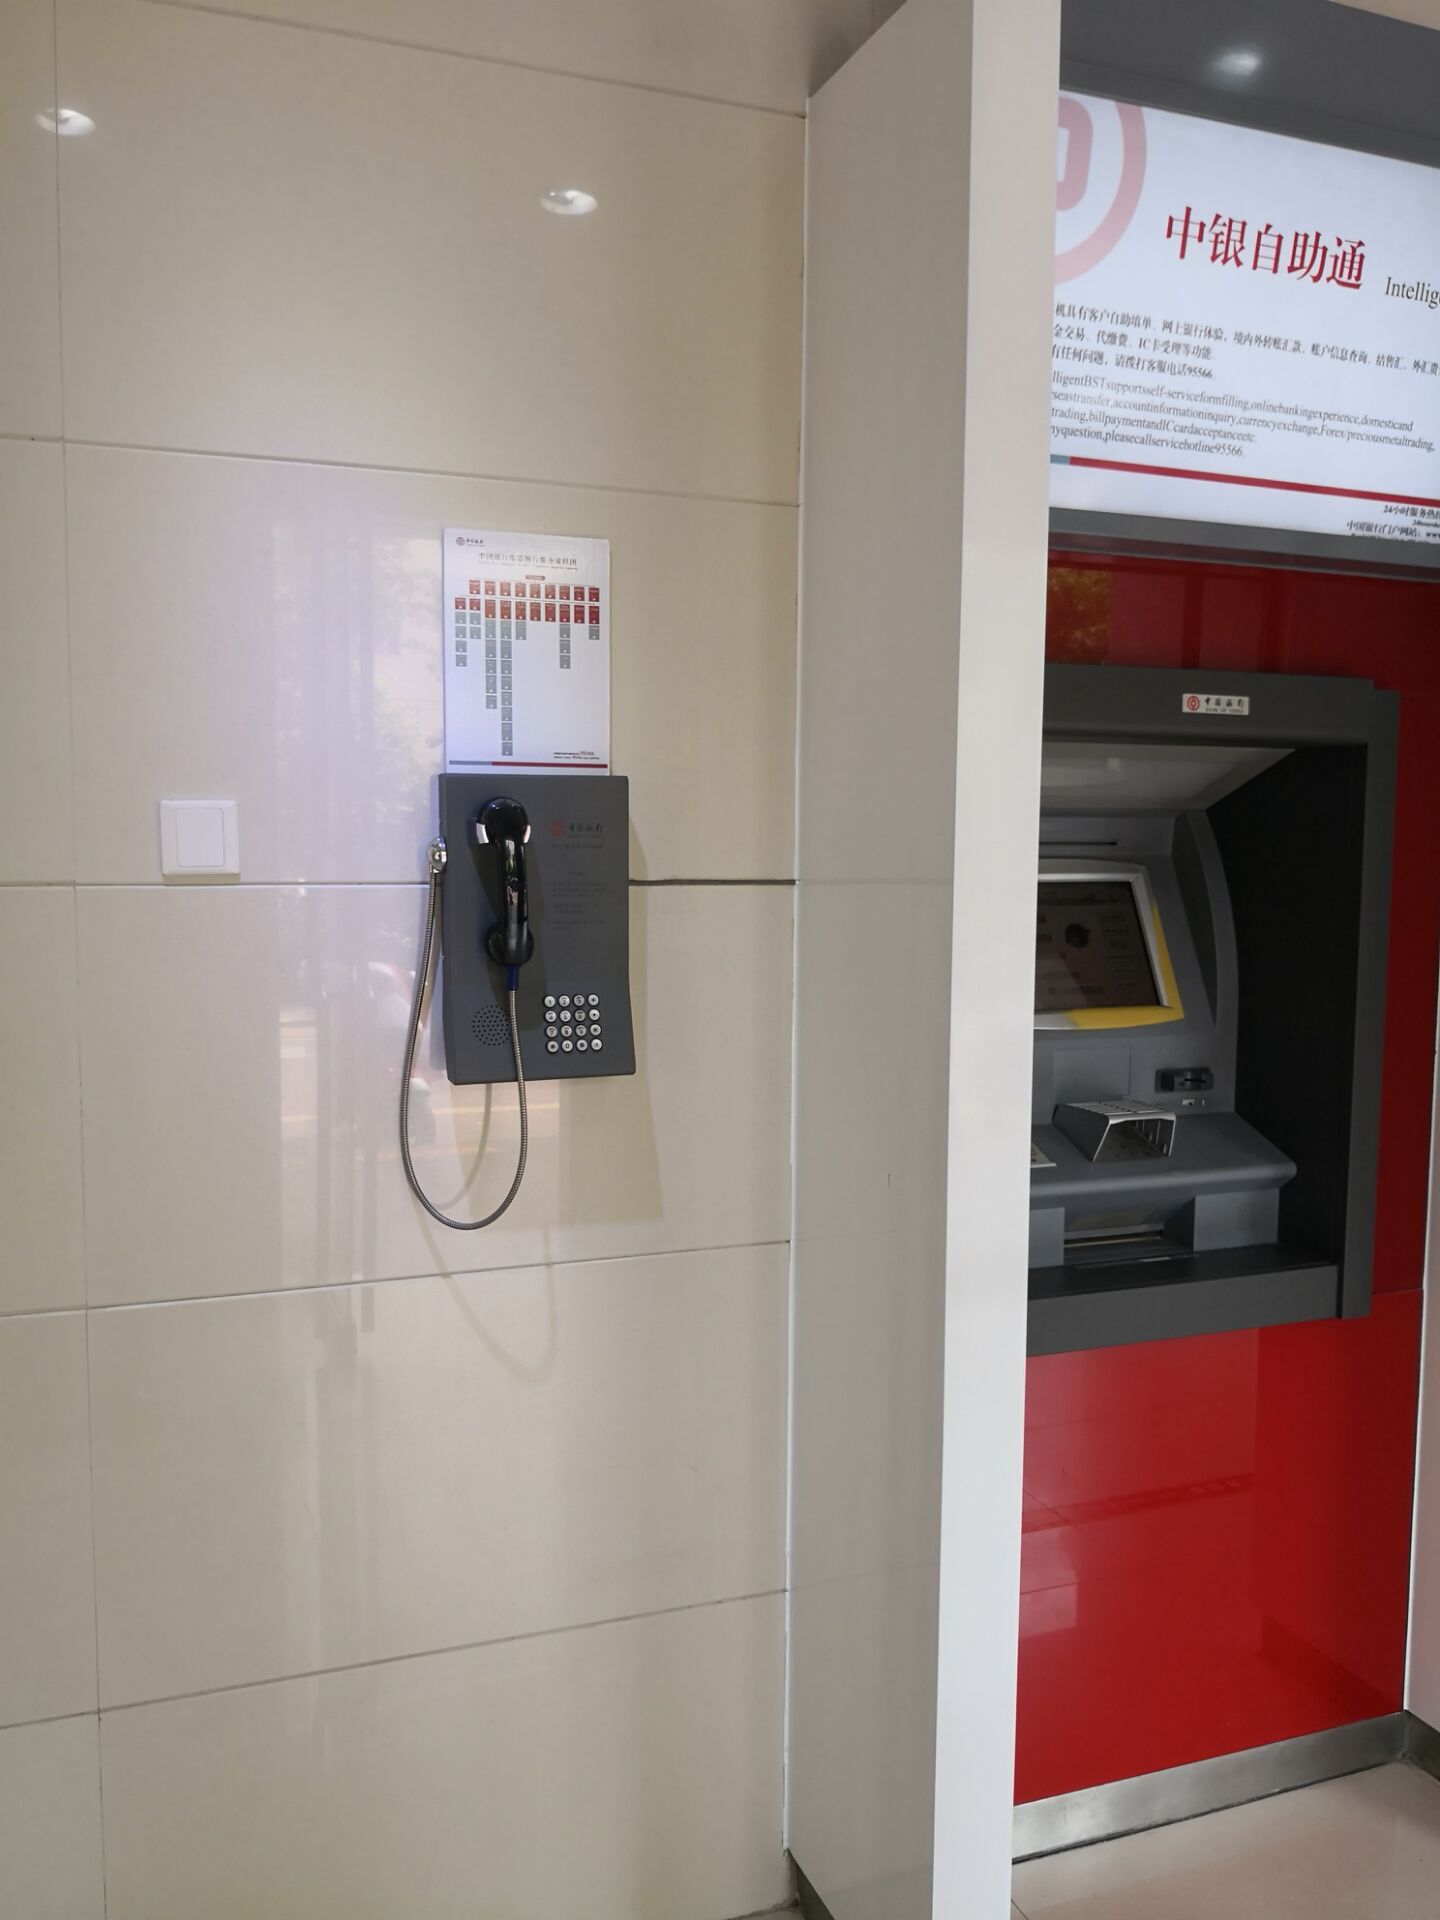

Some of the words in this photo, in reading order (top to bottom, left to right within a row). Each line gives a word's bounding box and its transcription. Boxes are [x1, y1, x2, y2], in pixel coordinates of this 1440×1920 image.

[1165, 206, 1366, 290] 中银自助通
[1385, 277, 1440, 309] Intellig
